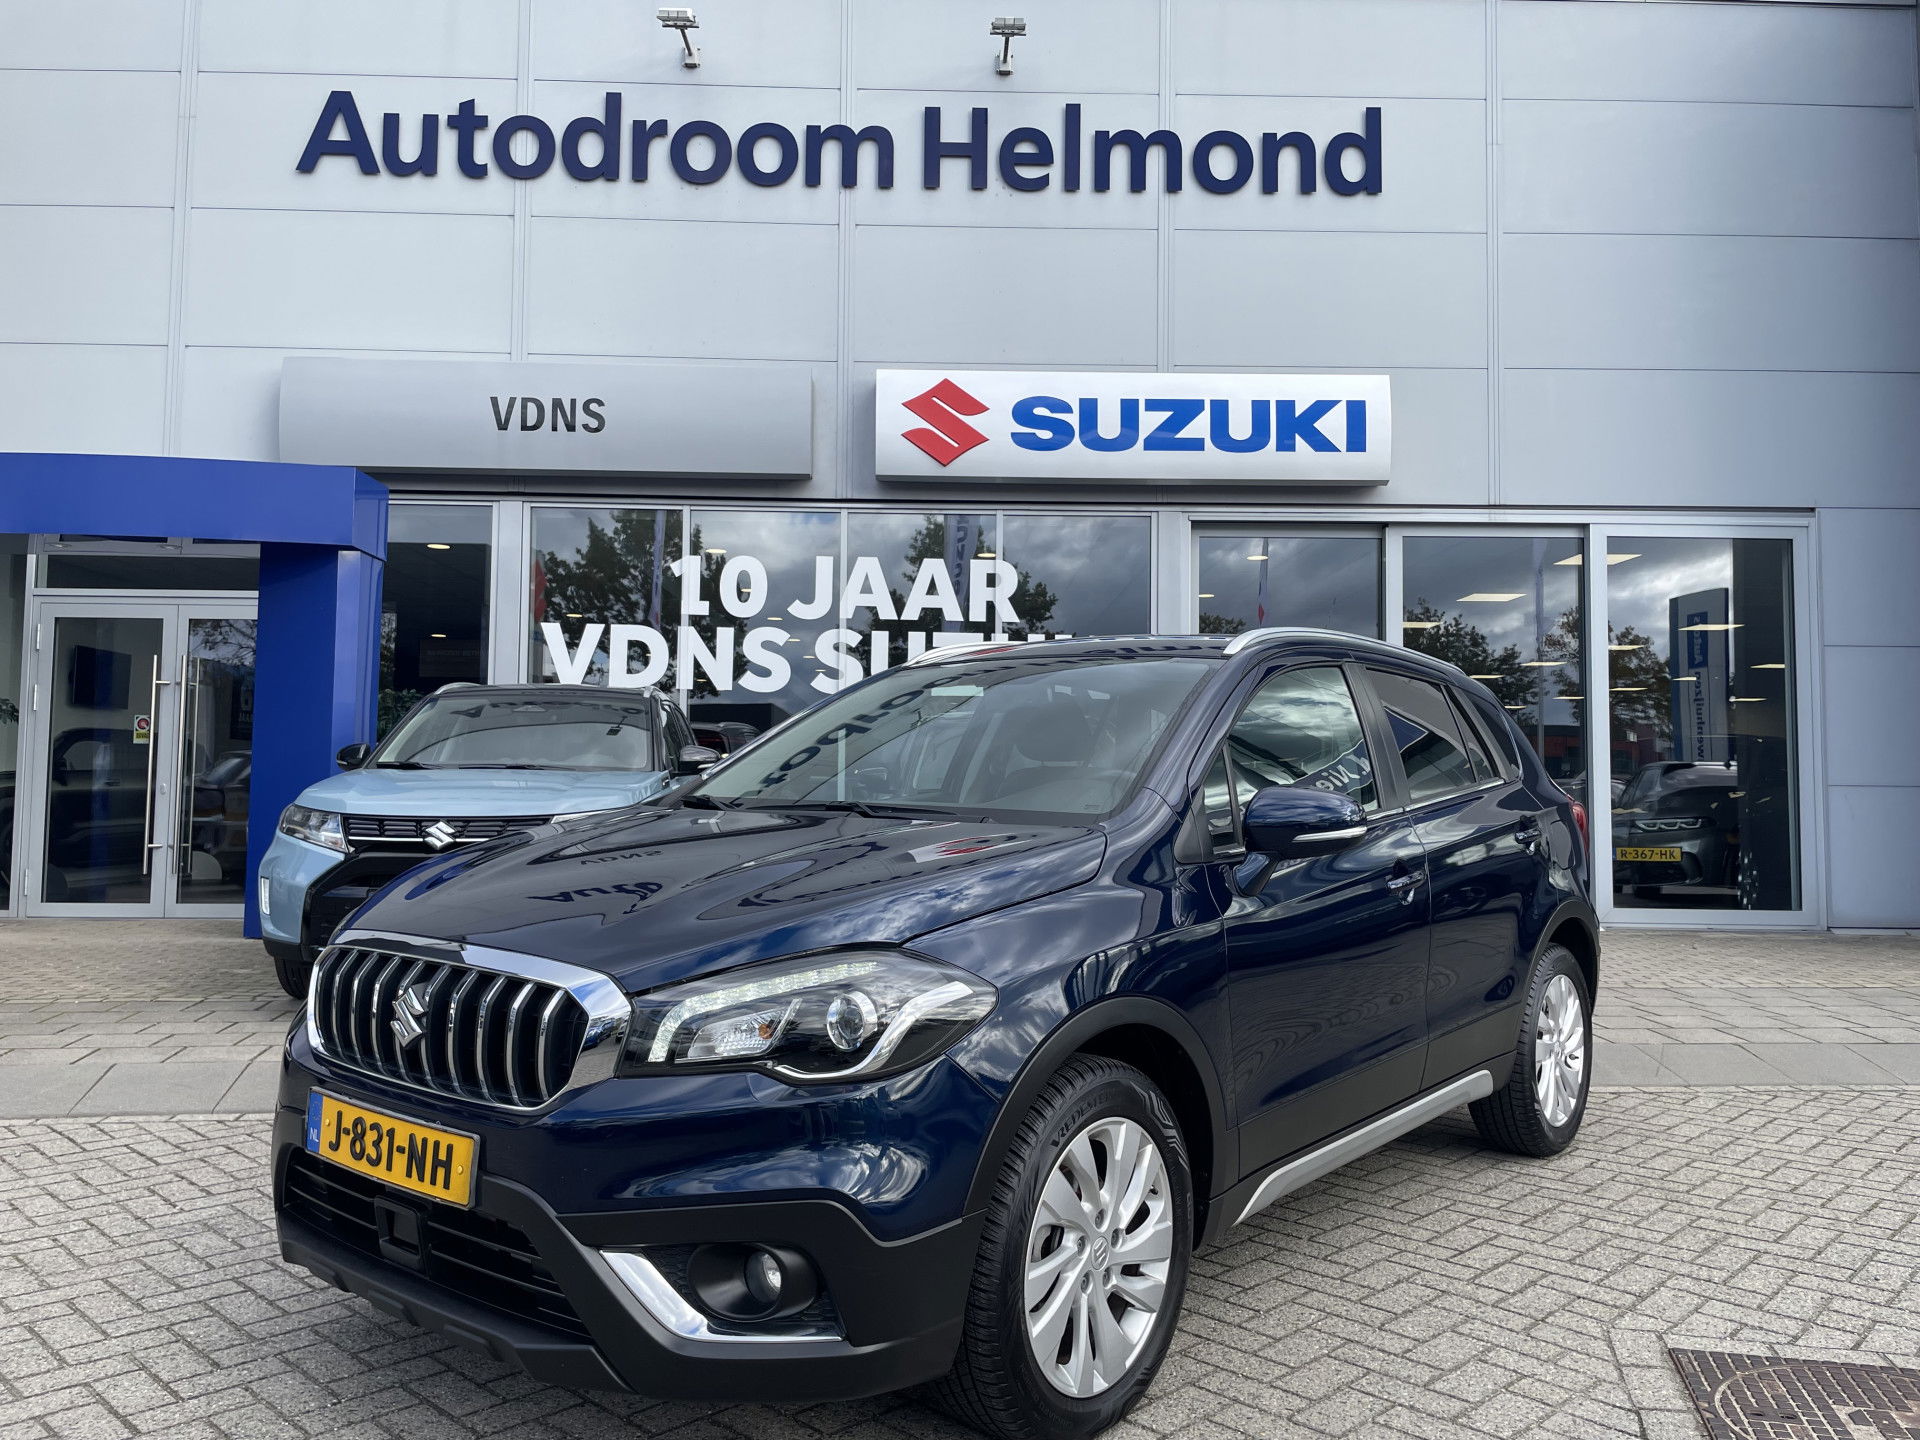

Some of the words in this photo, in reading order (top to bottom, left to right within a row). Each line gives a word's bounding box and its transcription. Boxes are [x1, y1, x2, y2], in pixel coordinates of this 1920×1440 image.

[295, 91, 894, 190] Autodroom
[924, 103, 1382, 196] Helmond
[490, 396, 606, 433] VDNS
[1010, 395, 1367, 453] SUZUKI
[670, 555, 768, 618] 10
[787, 556, 1020, 623] JAAR
[541, 622, 791, 692] VDNS
[1620, 849, 1676, 860] R-367-HK
[309, 1127, 319, 1143] NL
[328, 1110, 454, 1190] J-831-NH
